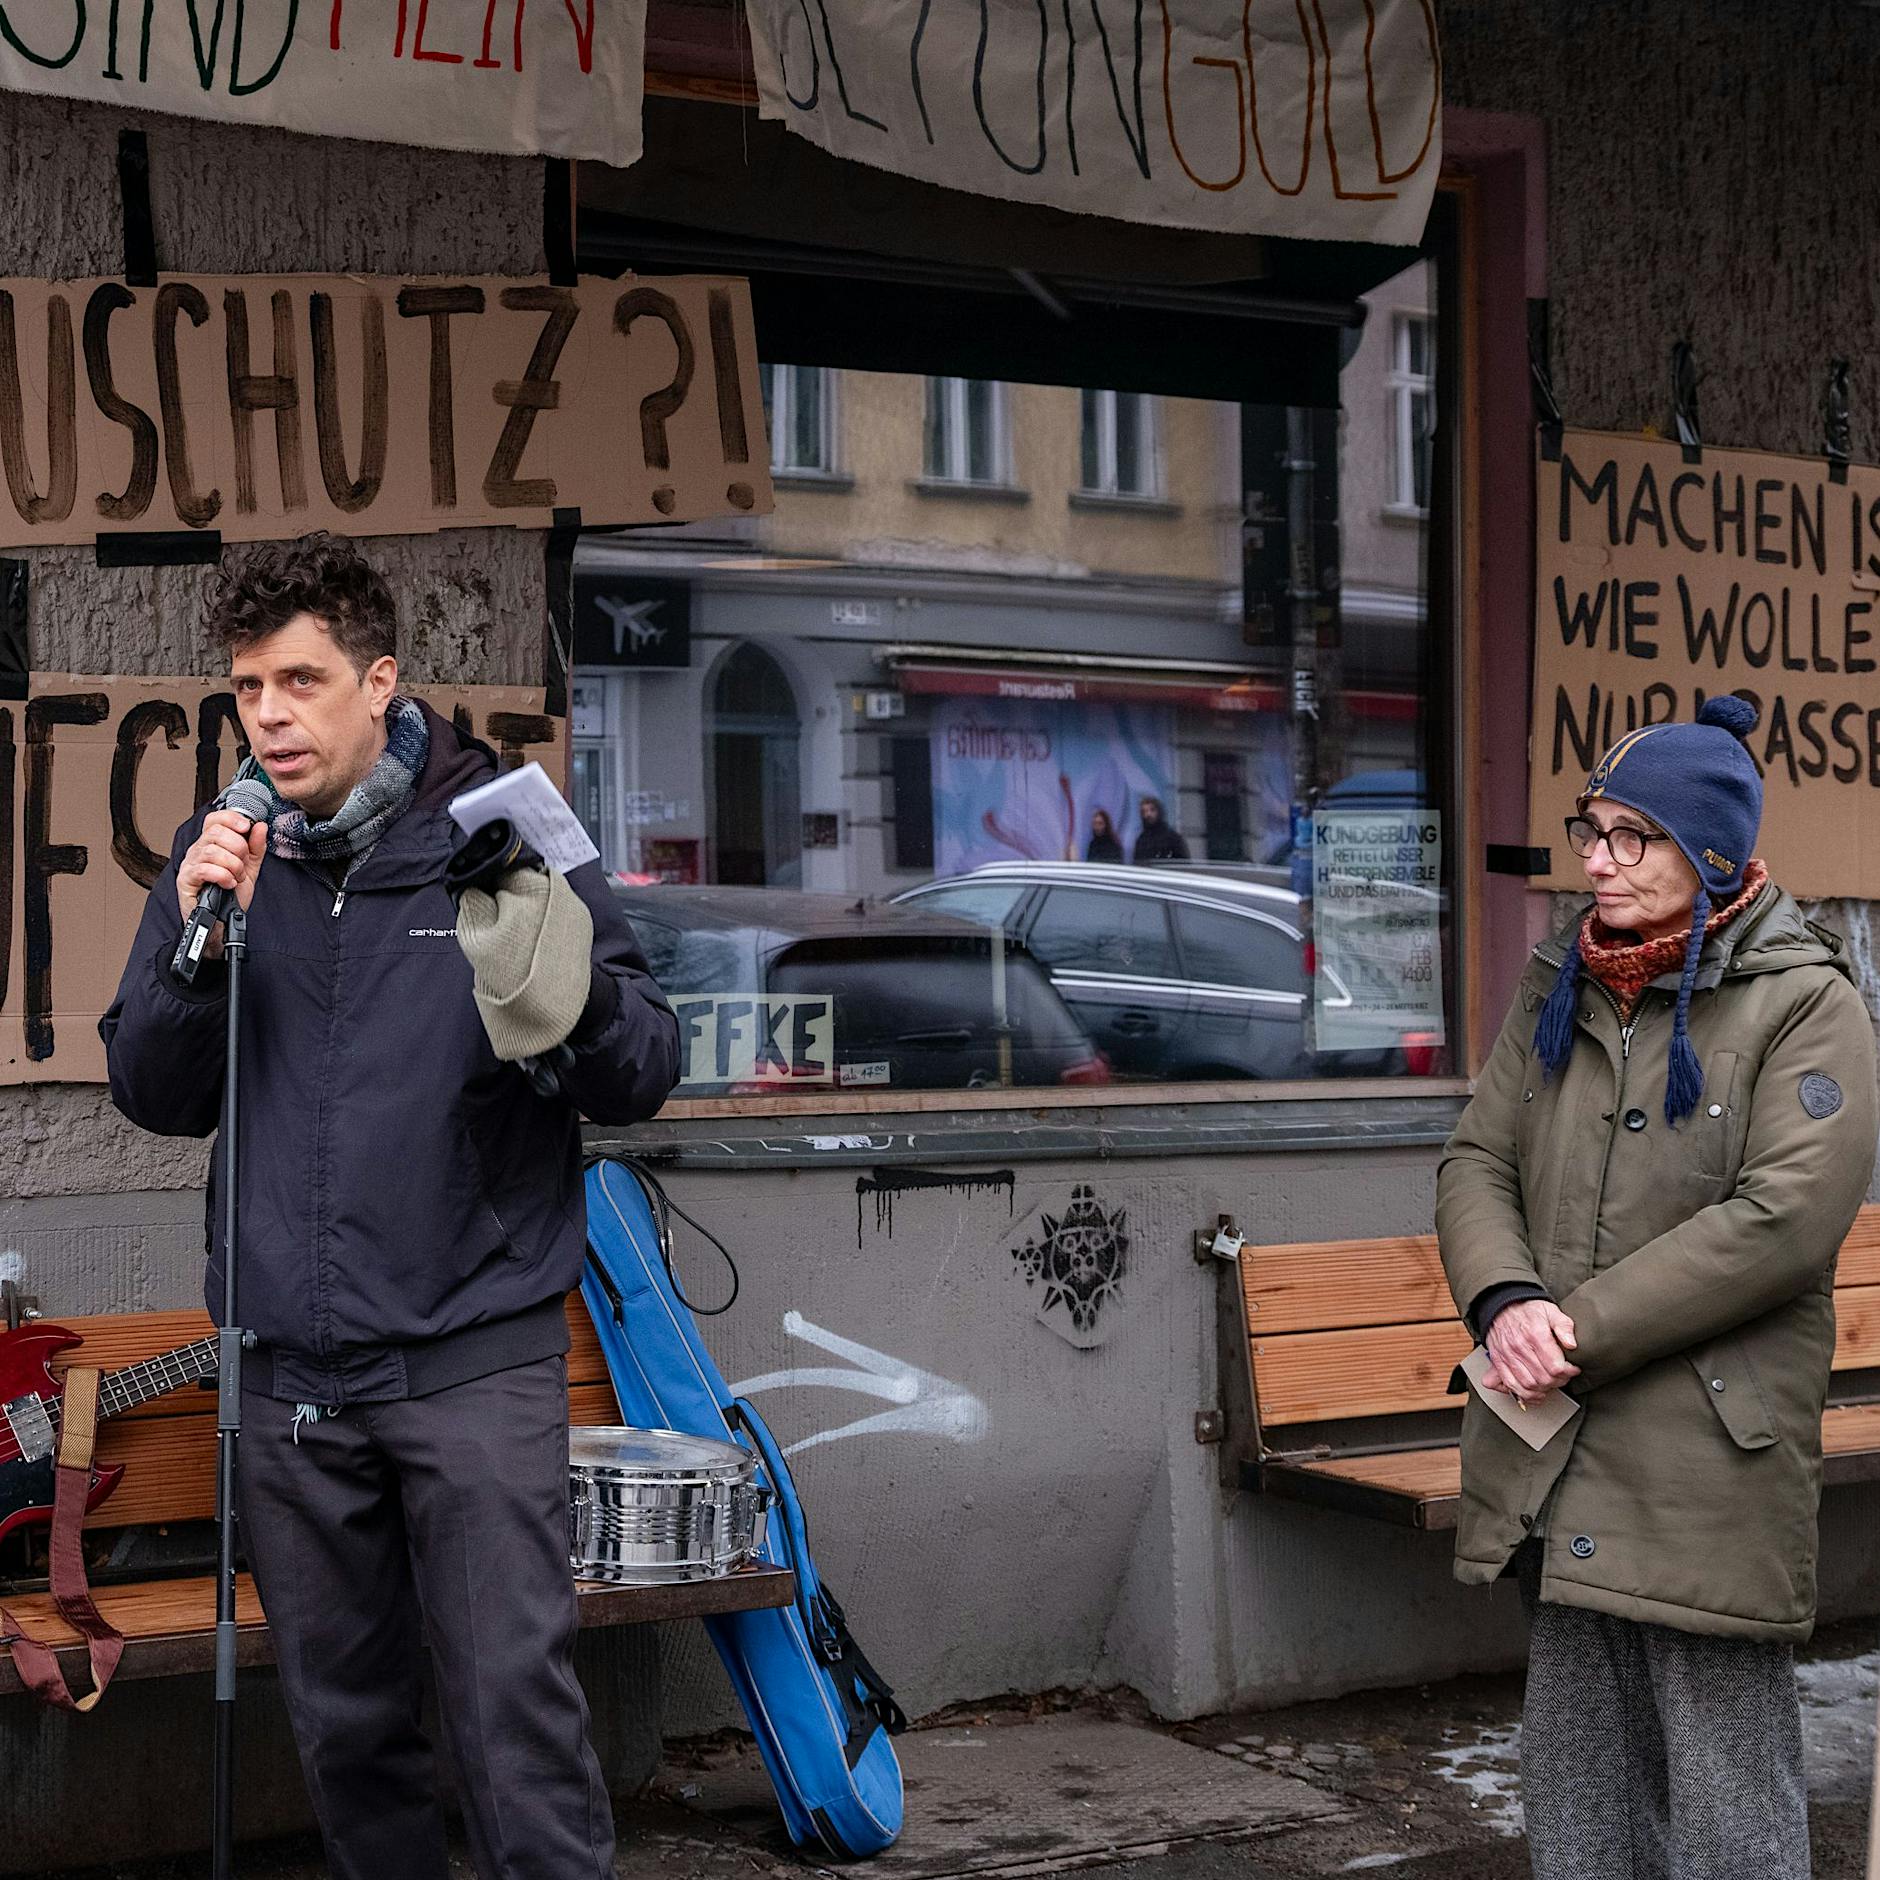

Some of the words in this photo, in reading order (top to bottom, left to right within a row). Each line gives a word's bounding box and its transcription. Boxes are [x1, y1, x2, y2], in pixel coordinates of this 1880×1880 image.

[1558, 454, 1827, 576] MACHEN
[1554, 574, 1661, 660] WIE
[1676, 574, 1877, 674] WOLLE
[1316, 824, 1438, 845] KUNDGEBUNG
[1333, 847, 1380, 863] RETTET
[1381, 847, 1424, 863] UNSER
[676, 999, 827, 1077] FFKE
